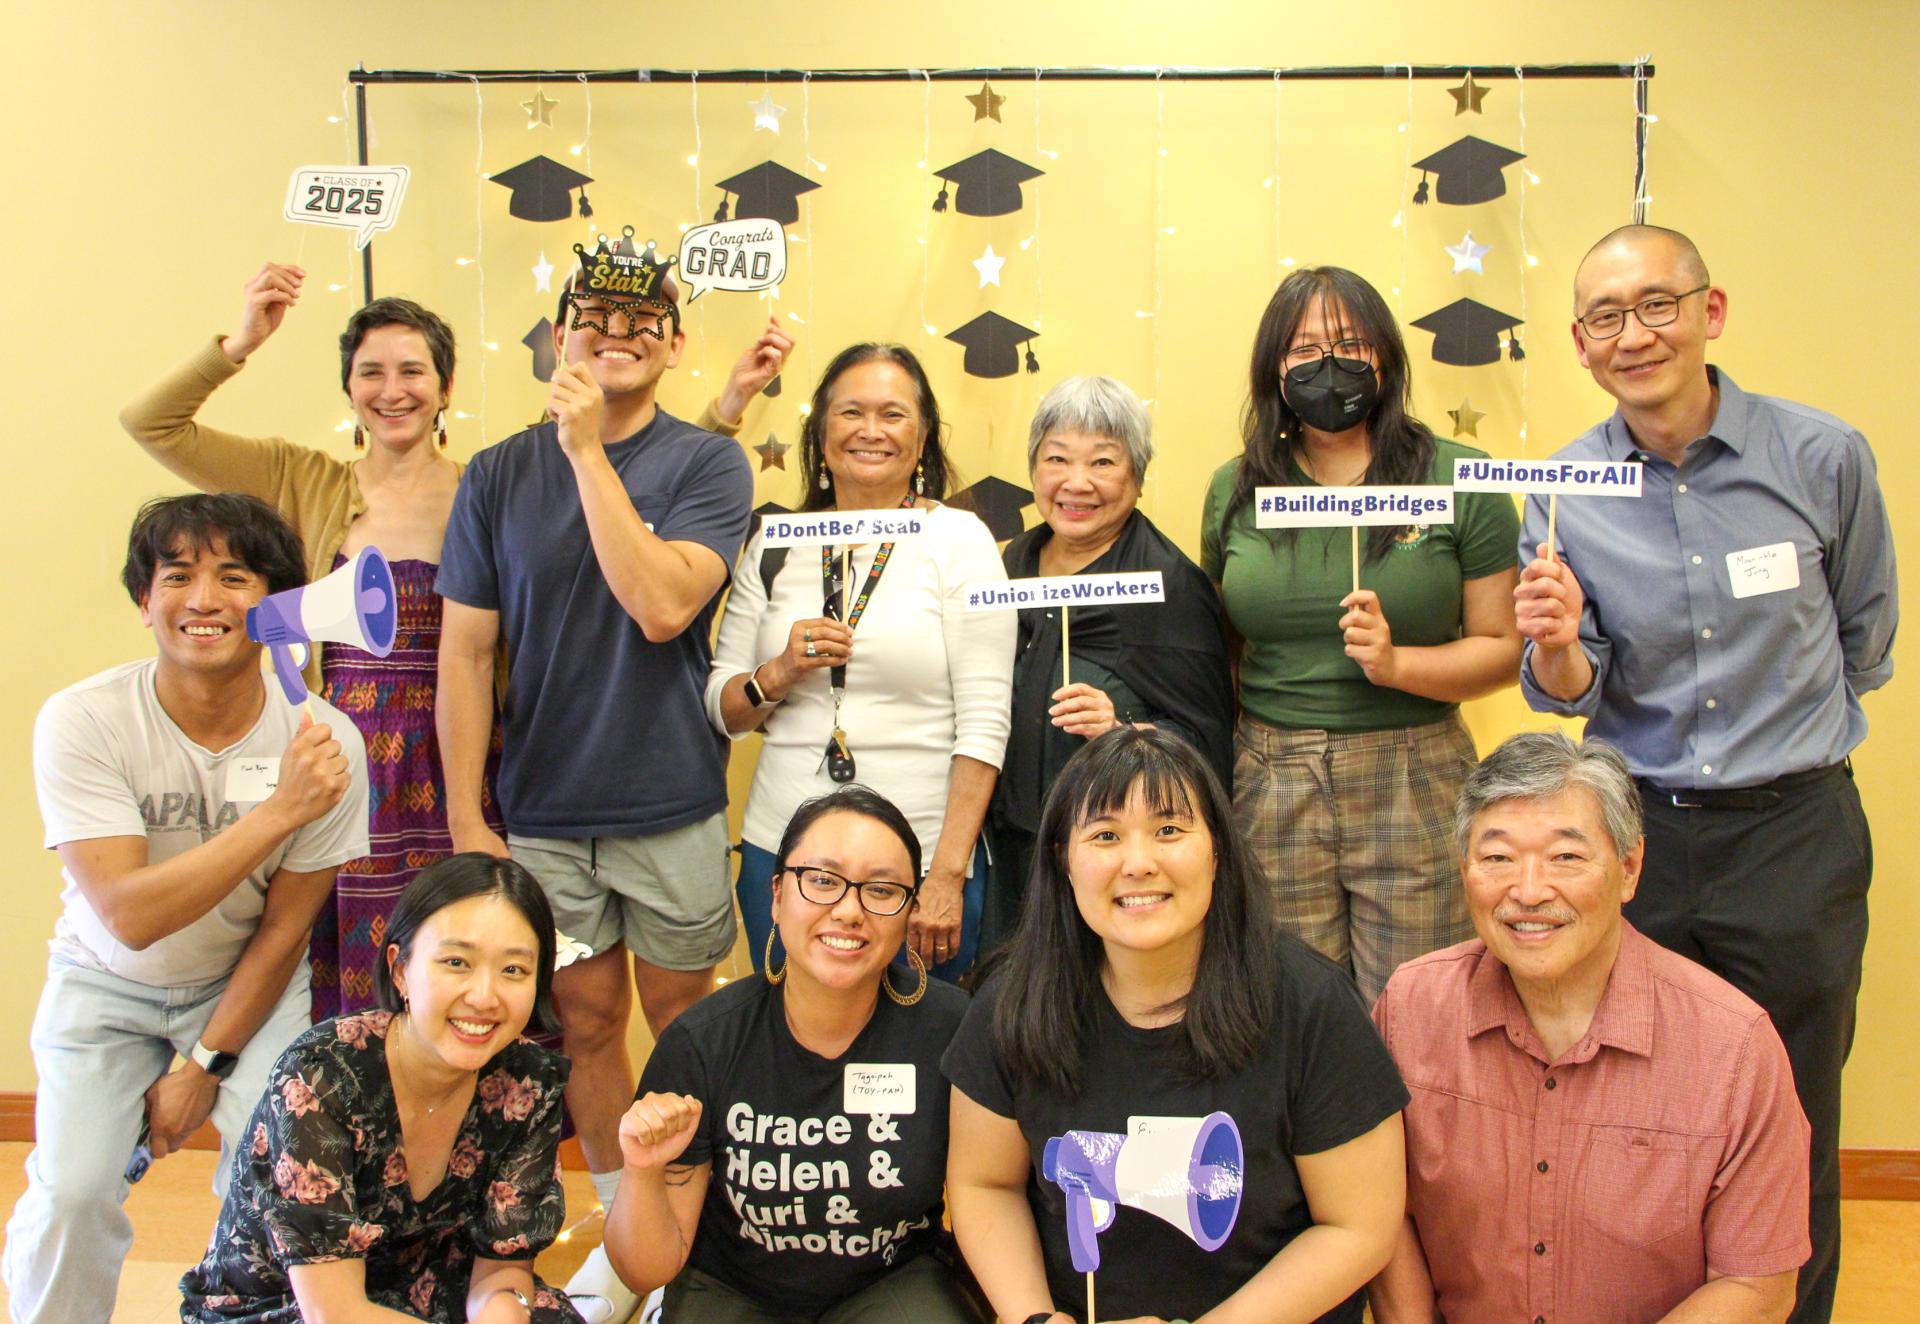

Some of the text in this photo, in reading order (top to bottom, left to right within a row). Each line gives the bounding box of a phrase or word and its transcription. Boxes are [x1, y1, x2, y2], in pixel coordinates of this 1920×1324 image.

[323, 175, 374, 188] CLASS OF
[305, 185, 384, 215] 2025
[709, 227, 775, 252] Congrats
[612, 255, 644, 268] YOU'RE
[623, 266, 630, 276] A
[686, 246, 772, 280] GRAD
[590, 264, 657, 296] Star!
[1457, 461, 1637, 486] #UnionsForAll
[1260, 494, 1449, 517] #BuildingBridges
[969, 581, 1160, 607] #UnioizeWorkers
[726, 1102, 902, 1146] Grace &
[725, 1146, 905, 1192] Helen &
[725, 1183, 861, 1227] Yuri &
